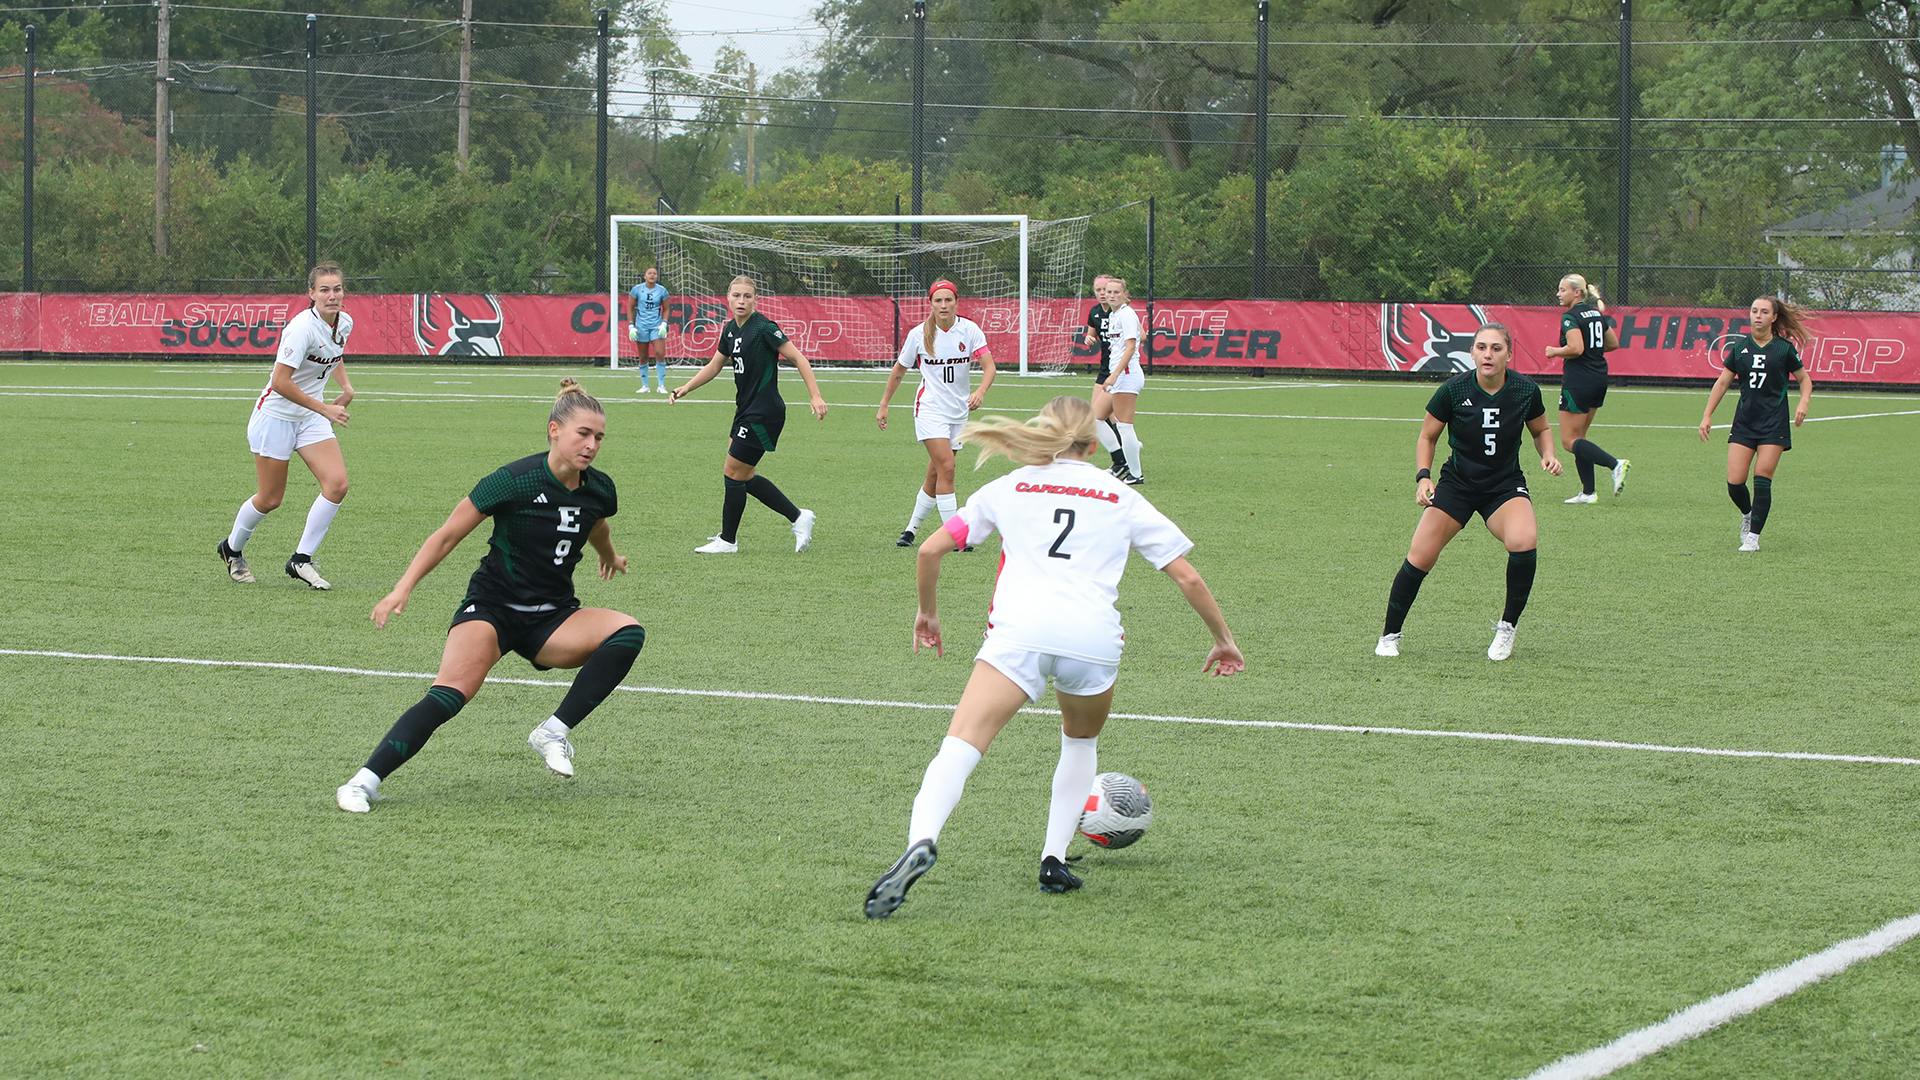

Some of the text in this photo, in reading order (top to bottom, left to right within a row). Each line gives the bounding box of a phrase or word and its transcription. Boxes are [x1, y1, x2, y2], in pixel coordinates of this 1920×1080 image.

[89, 303, 289, 327] BALL STATE
[981, 307, 1229, 337] BALL TATE
[160, 320, 279, 348] SOCC
[733, 338, 742, 353] E
[1071, 327, 1282, 359] SCCER
[1589, 320, 1604, 349] 19
[1752, 354, 1766, 369] E
[943, 366, 954, 384] 10
[1749, 372, 1767, 389] 27
[1482, 408, 1500, 428] E
[737, 426, 748, 439] E
[1484, 433, 1496, 456] 5
[1015, 482, 1120, 504] CARDINALS
[557, 506, 582, 533] E
[1048, 508, 1076, 560] 2
[554, 539, 572, 566] 9
